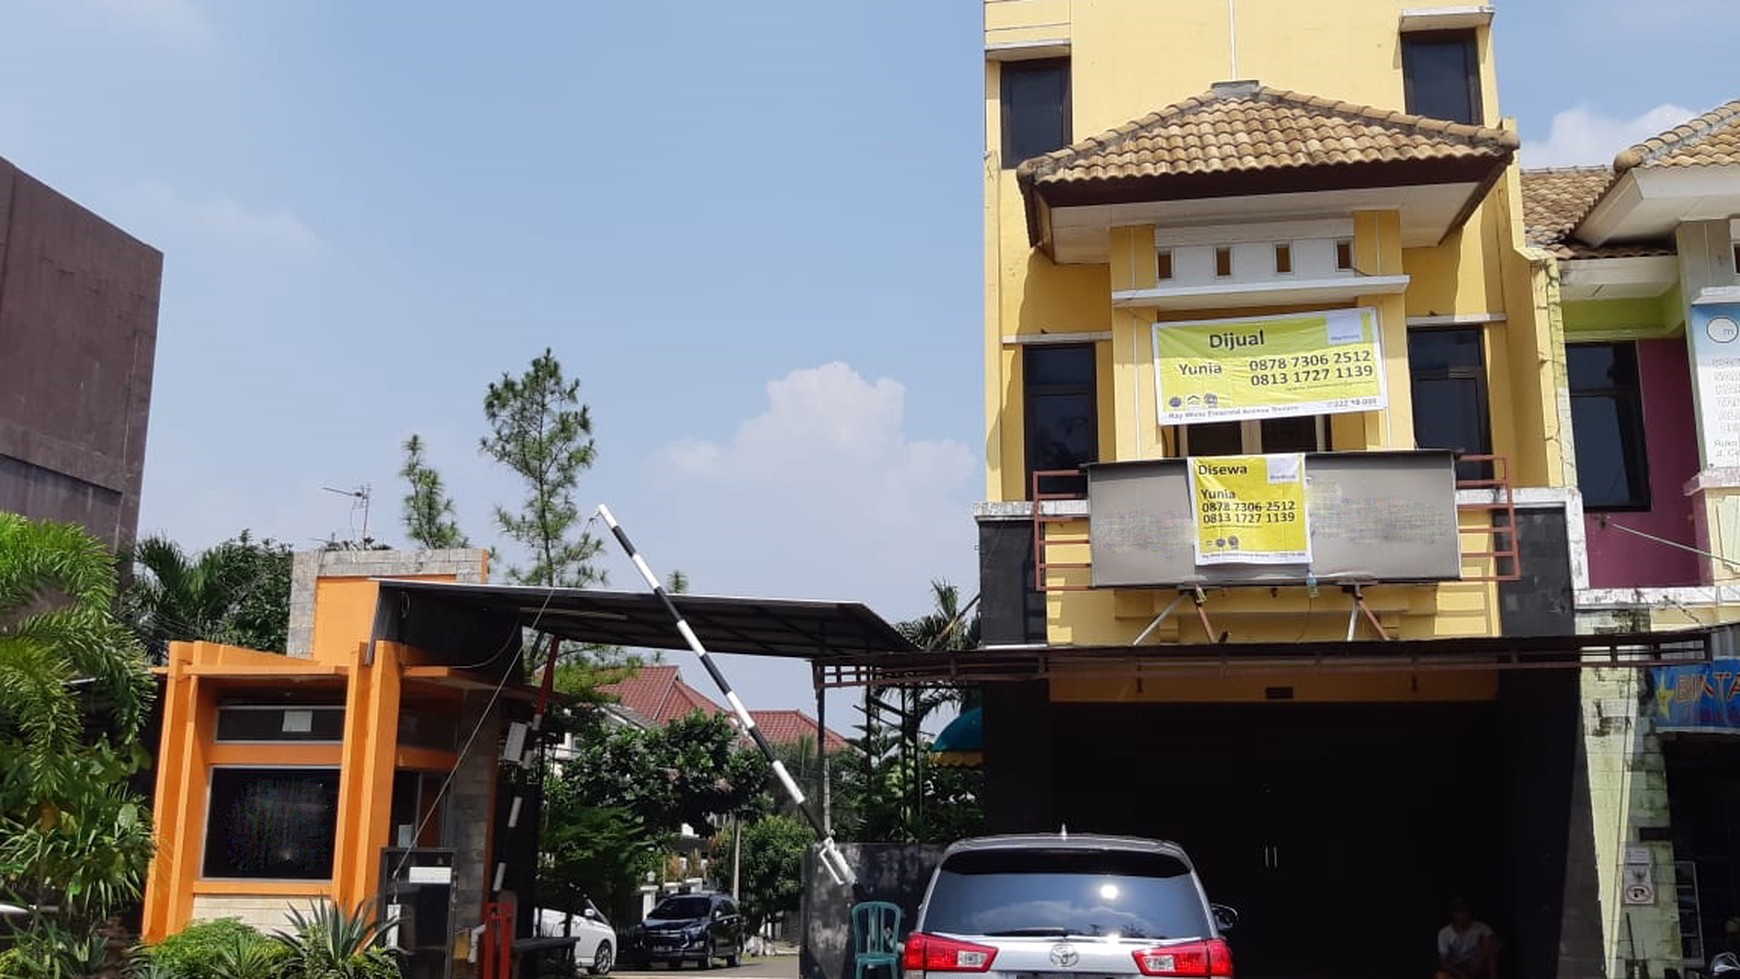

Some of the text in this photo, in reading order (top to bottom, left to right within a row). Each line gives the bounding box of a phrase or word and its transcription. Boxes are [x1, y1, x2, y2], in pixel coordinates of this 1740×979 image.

[1209, 329, 1264, 351] Dijual
[1249, 350, 1371, 372] 0878 7306 2512
[1179, 362, 1222, 375] Yunia
[1251, 372, 1288, 386] 0813
[1294, 368, 1330, 383] 1727
[1336, 365, 1373, 378] 1139
[1198, 465, 1248, 475] Disewa
[1200, 489, 1236, 500] Yunia
[1202, 501, 1295, 513] 0878 7306 2512
[1203, 512, 1295, 524] 0813 1727 1139
